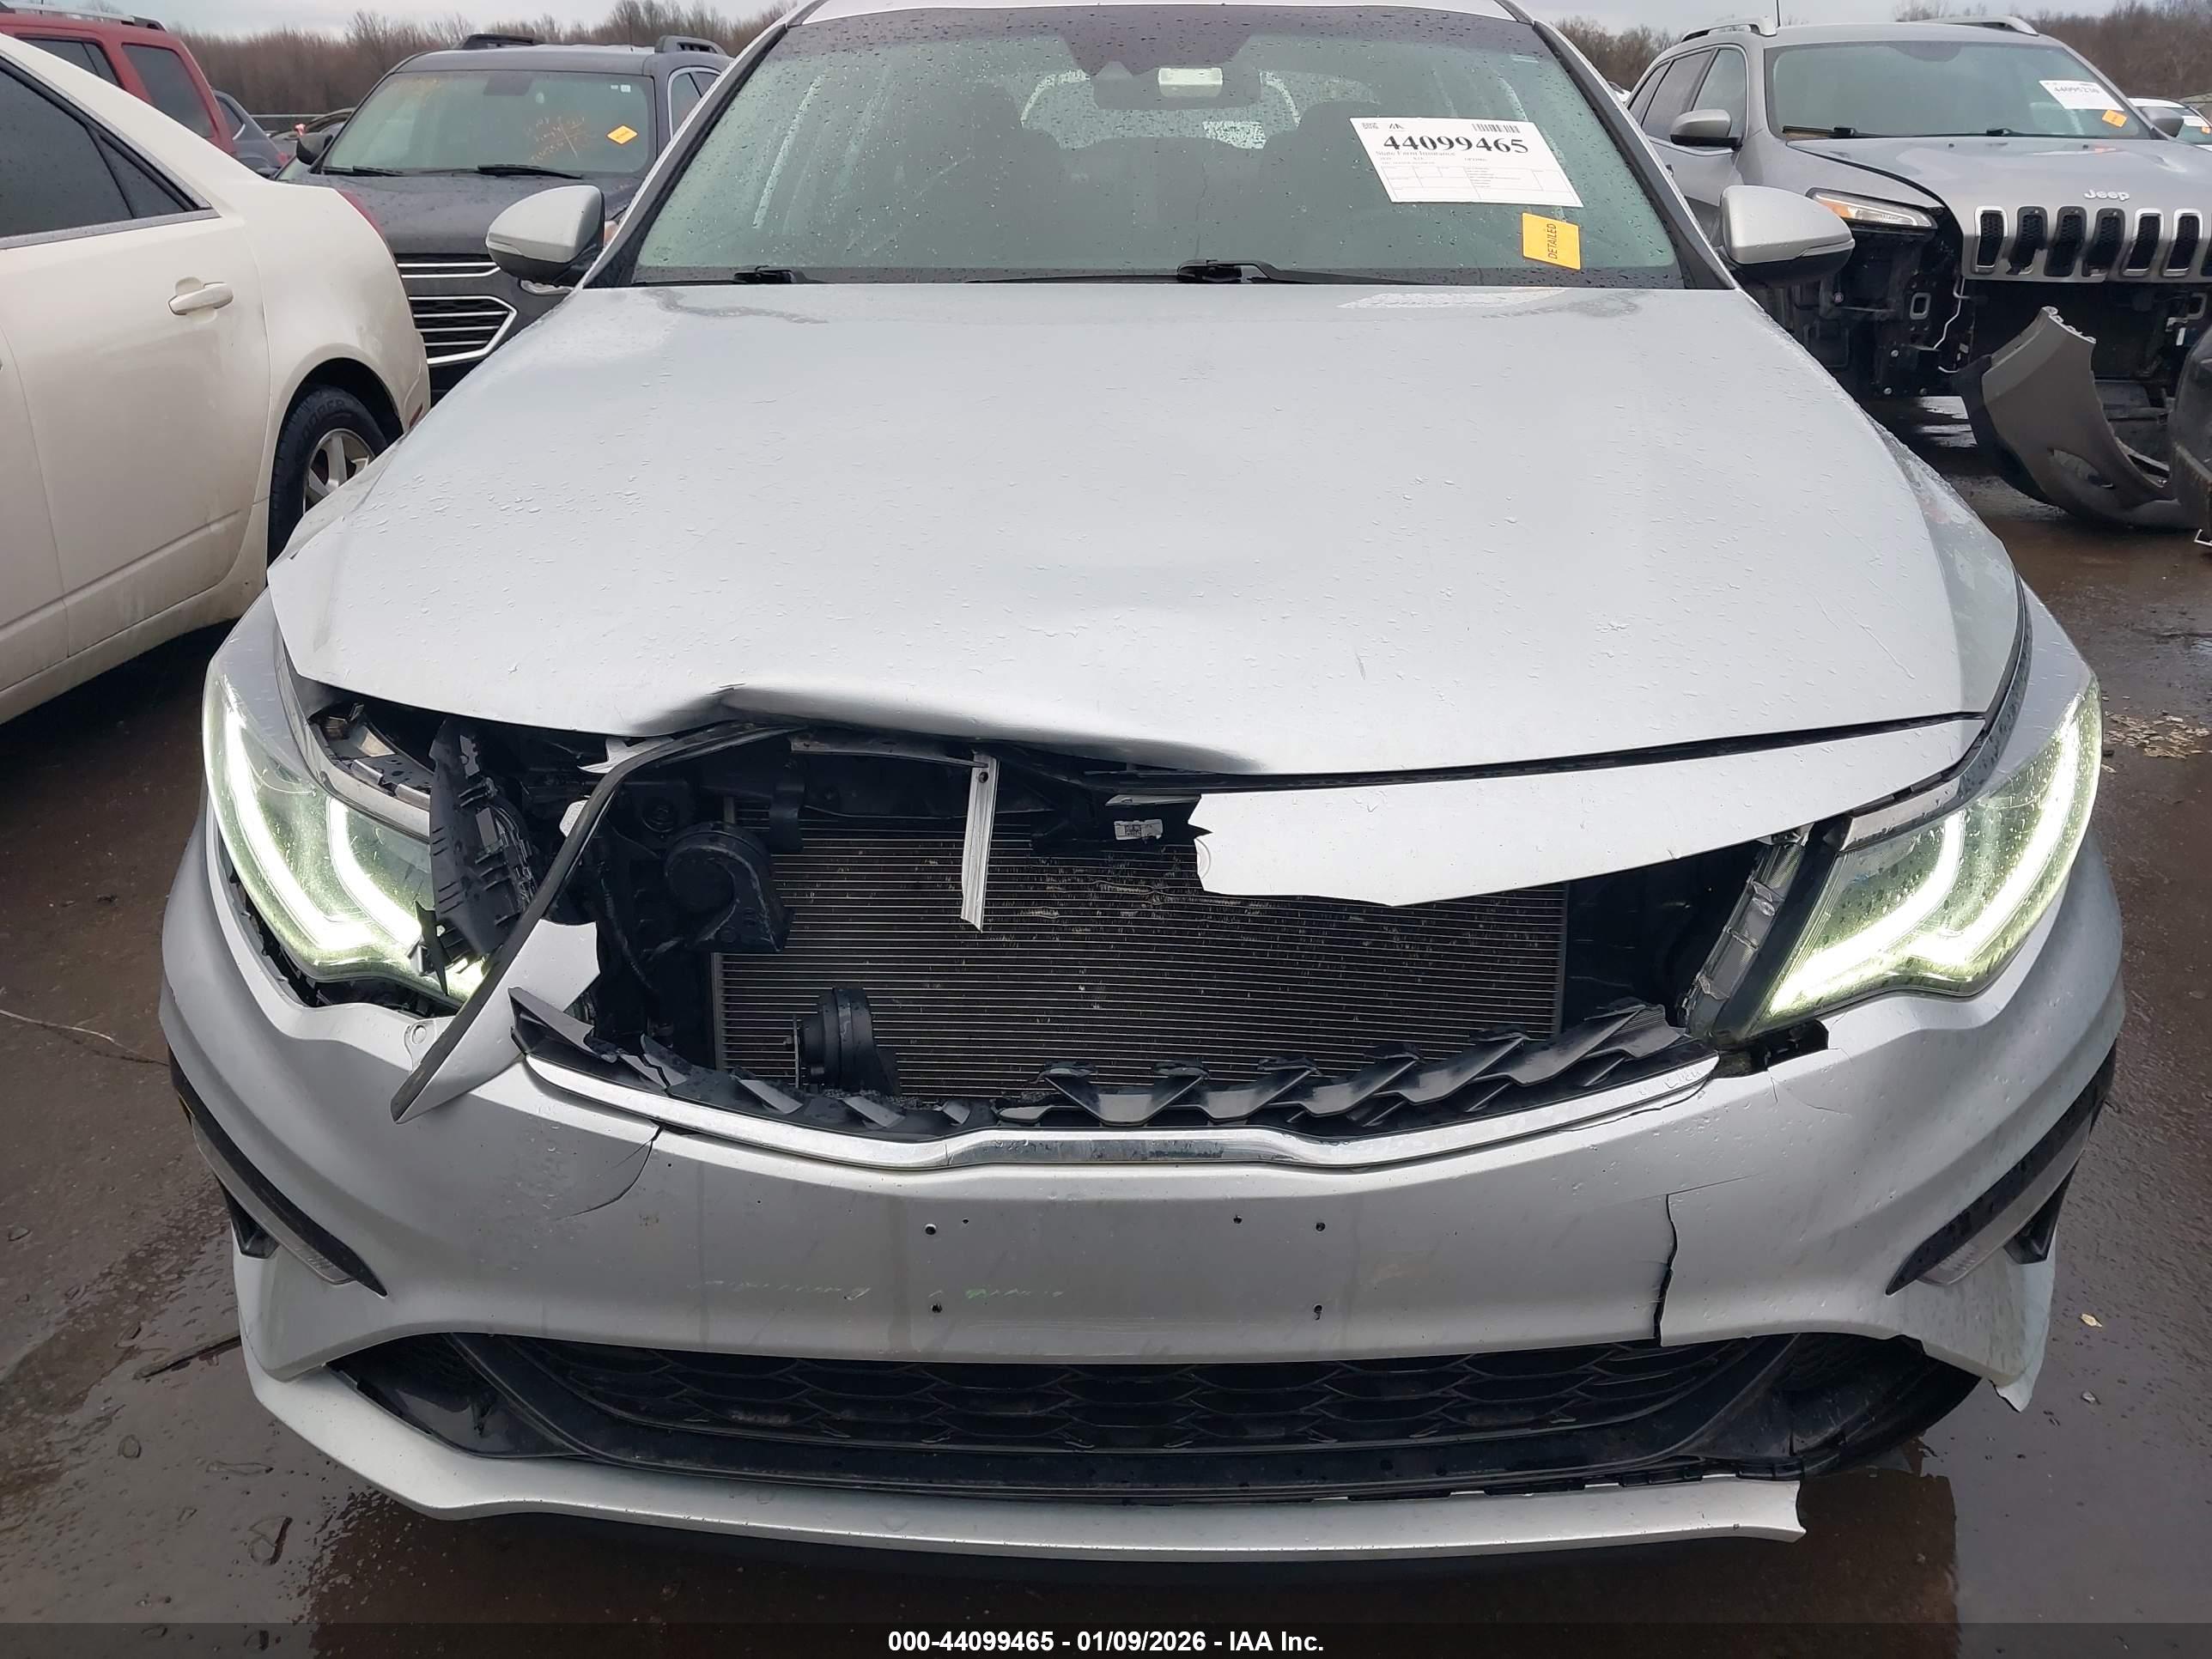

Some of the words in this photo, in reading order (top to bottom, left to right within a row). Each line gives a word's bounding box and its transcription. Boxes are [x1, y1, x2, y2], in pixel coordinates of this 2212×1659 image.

[1383, 136, 1529, 154] 44099465
[2082, 188, 2130, 202] Jeep
[1546, 222, 1559, 260] DETAILED
